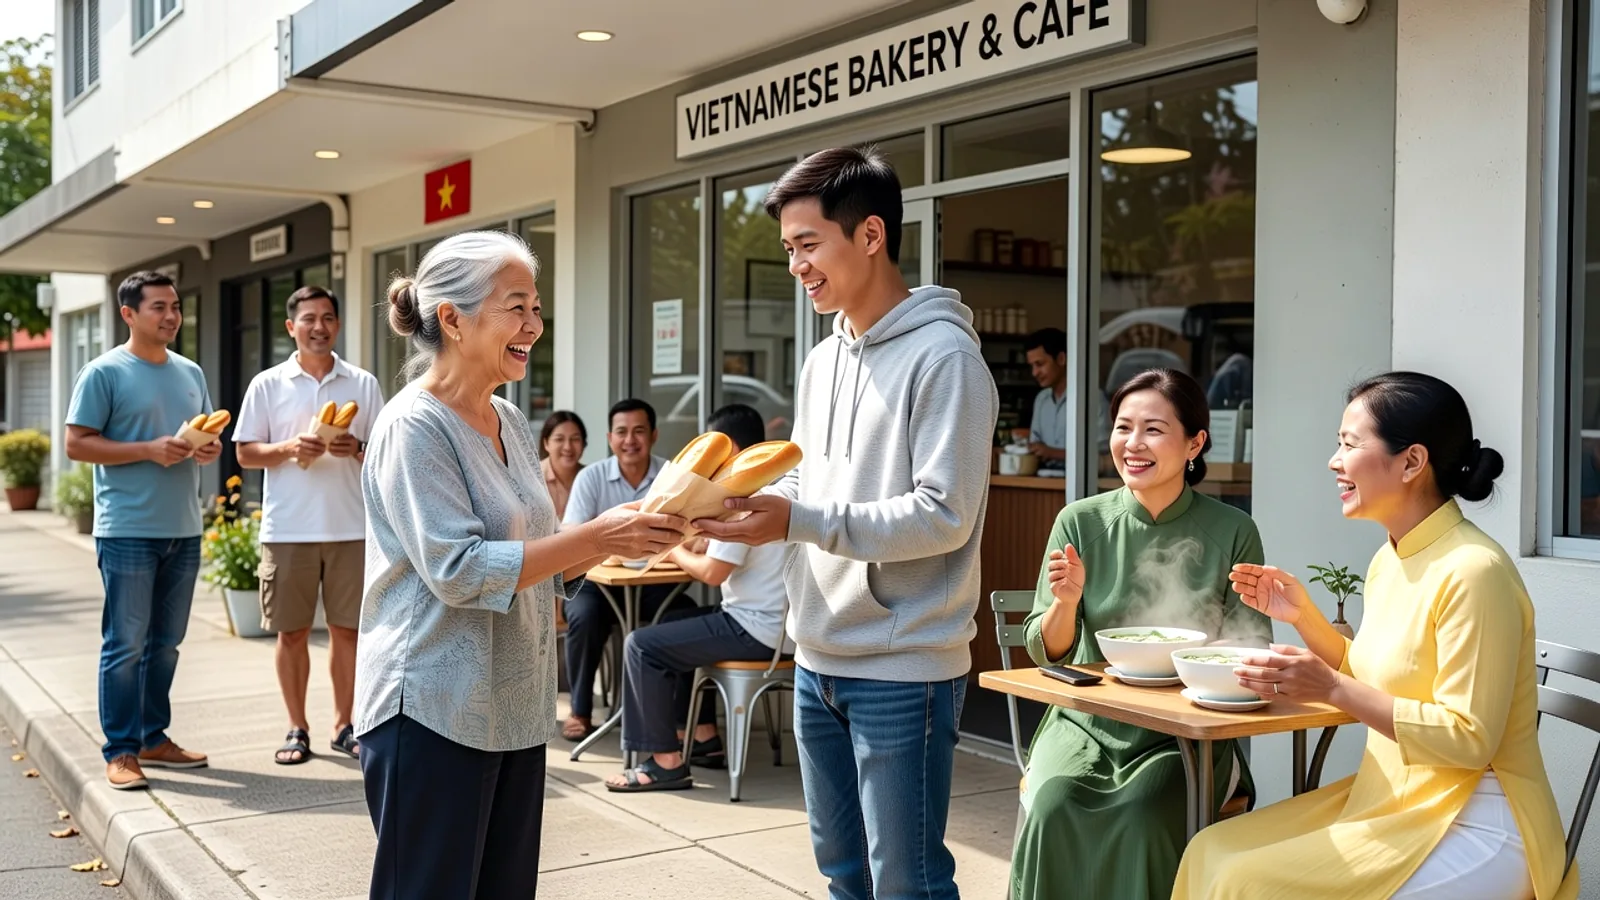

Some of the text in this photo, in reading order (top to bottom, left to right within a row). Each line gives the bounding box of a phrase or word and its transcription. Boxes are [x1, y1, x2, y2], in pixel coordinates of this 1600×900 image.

[685, 0, 1110, 141] VIETNAMESE BAKERY & CAFE
